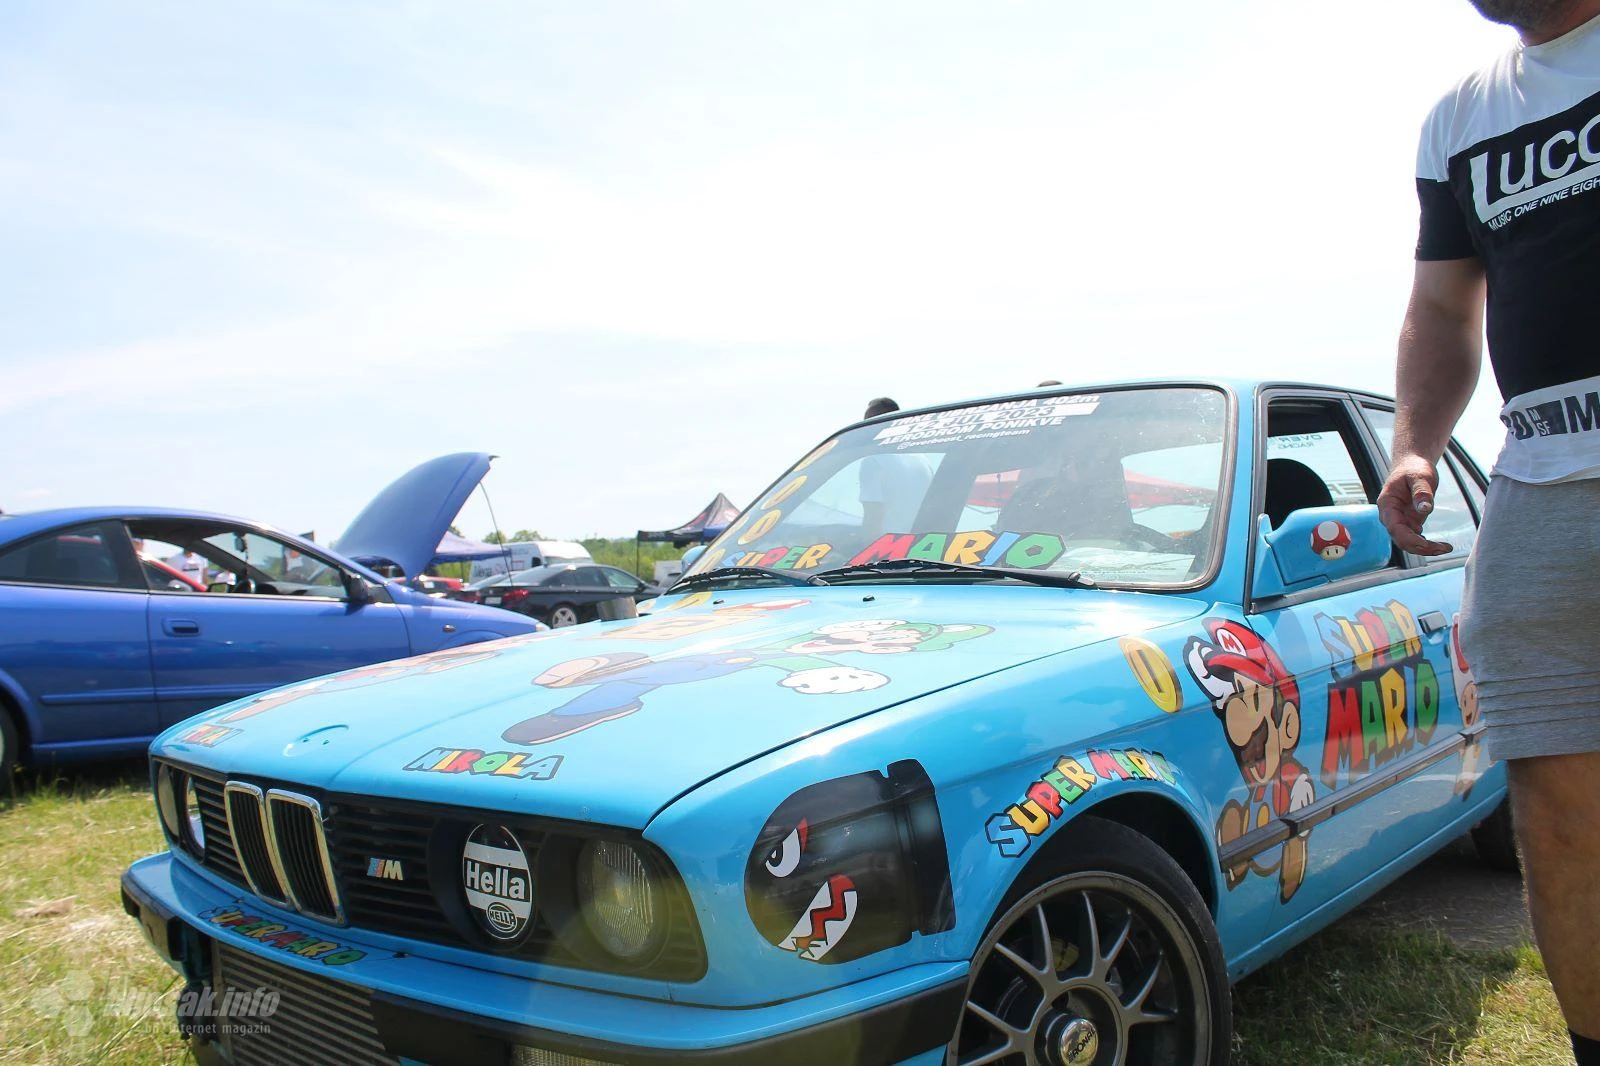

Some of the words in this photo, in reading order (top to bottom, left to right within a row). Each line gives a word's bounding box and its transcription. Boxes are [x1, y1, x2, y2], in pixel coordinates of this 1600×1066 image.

[1488, 210, 1512, 231] MUSIC
[1514, 200, 1540, 217] ONE
[1540, 188, 1569, 206] NINE
[878, 424, 976, 446] AERODROM
[979, 416, 1066, 431] PONIKVE
[993, 406, 1056, 421] 2023
[721, 543, 834, 569] SUPER
[846, 530, 1066, 569] MARIO
[1313, 599, 1423, 681] SUPER
[1322, 660, 1439, 787] MARIO
[402, 747, 564, 780] NIKOLA
[985, 755, 1097, 858] SUPER
[466, 861, 525, 900] Hella
[198, 904, 287, 938] SUPER
[260, 930, 368, 965] MARIO
[489, 910, 516, 925] HELLA
